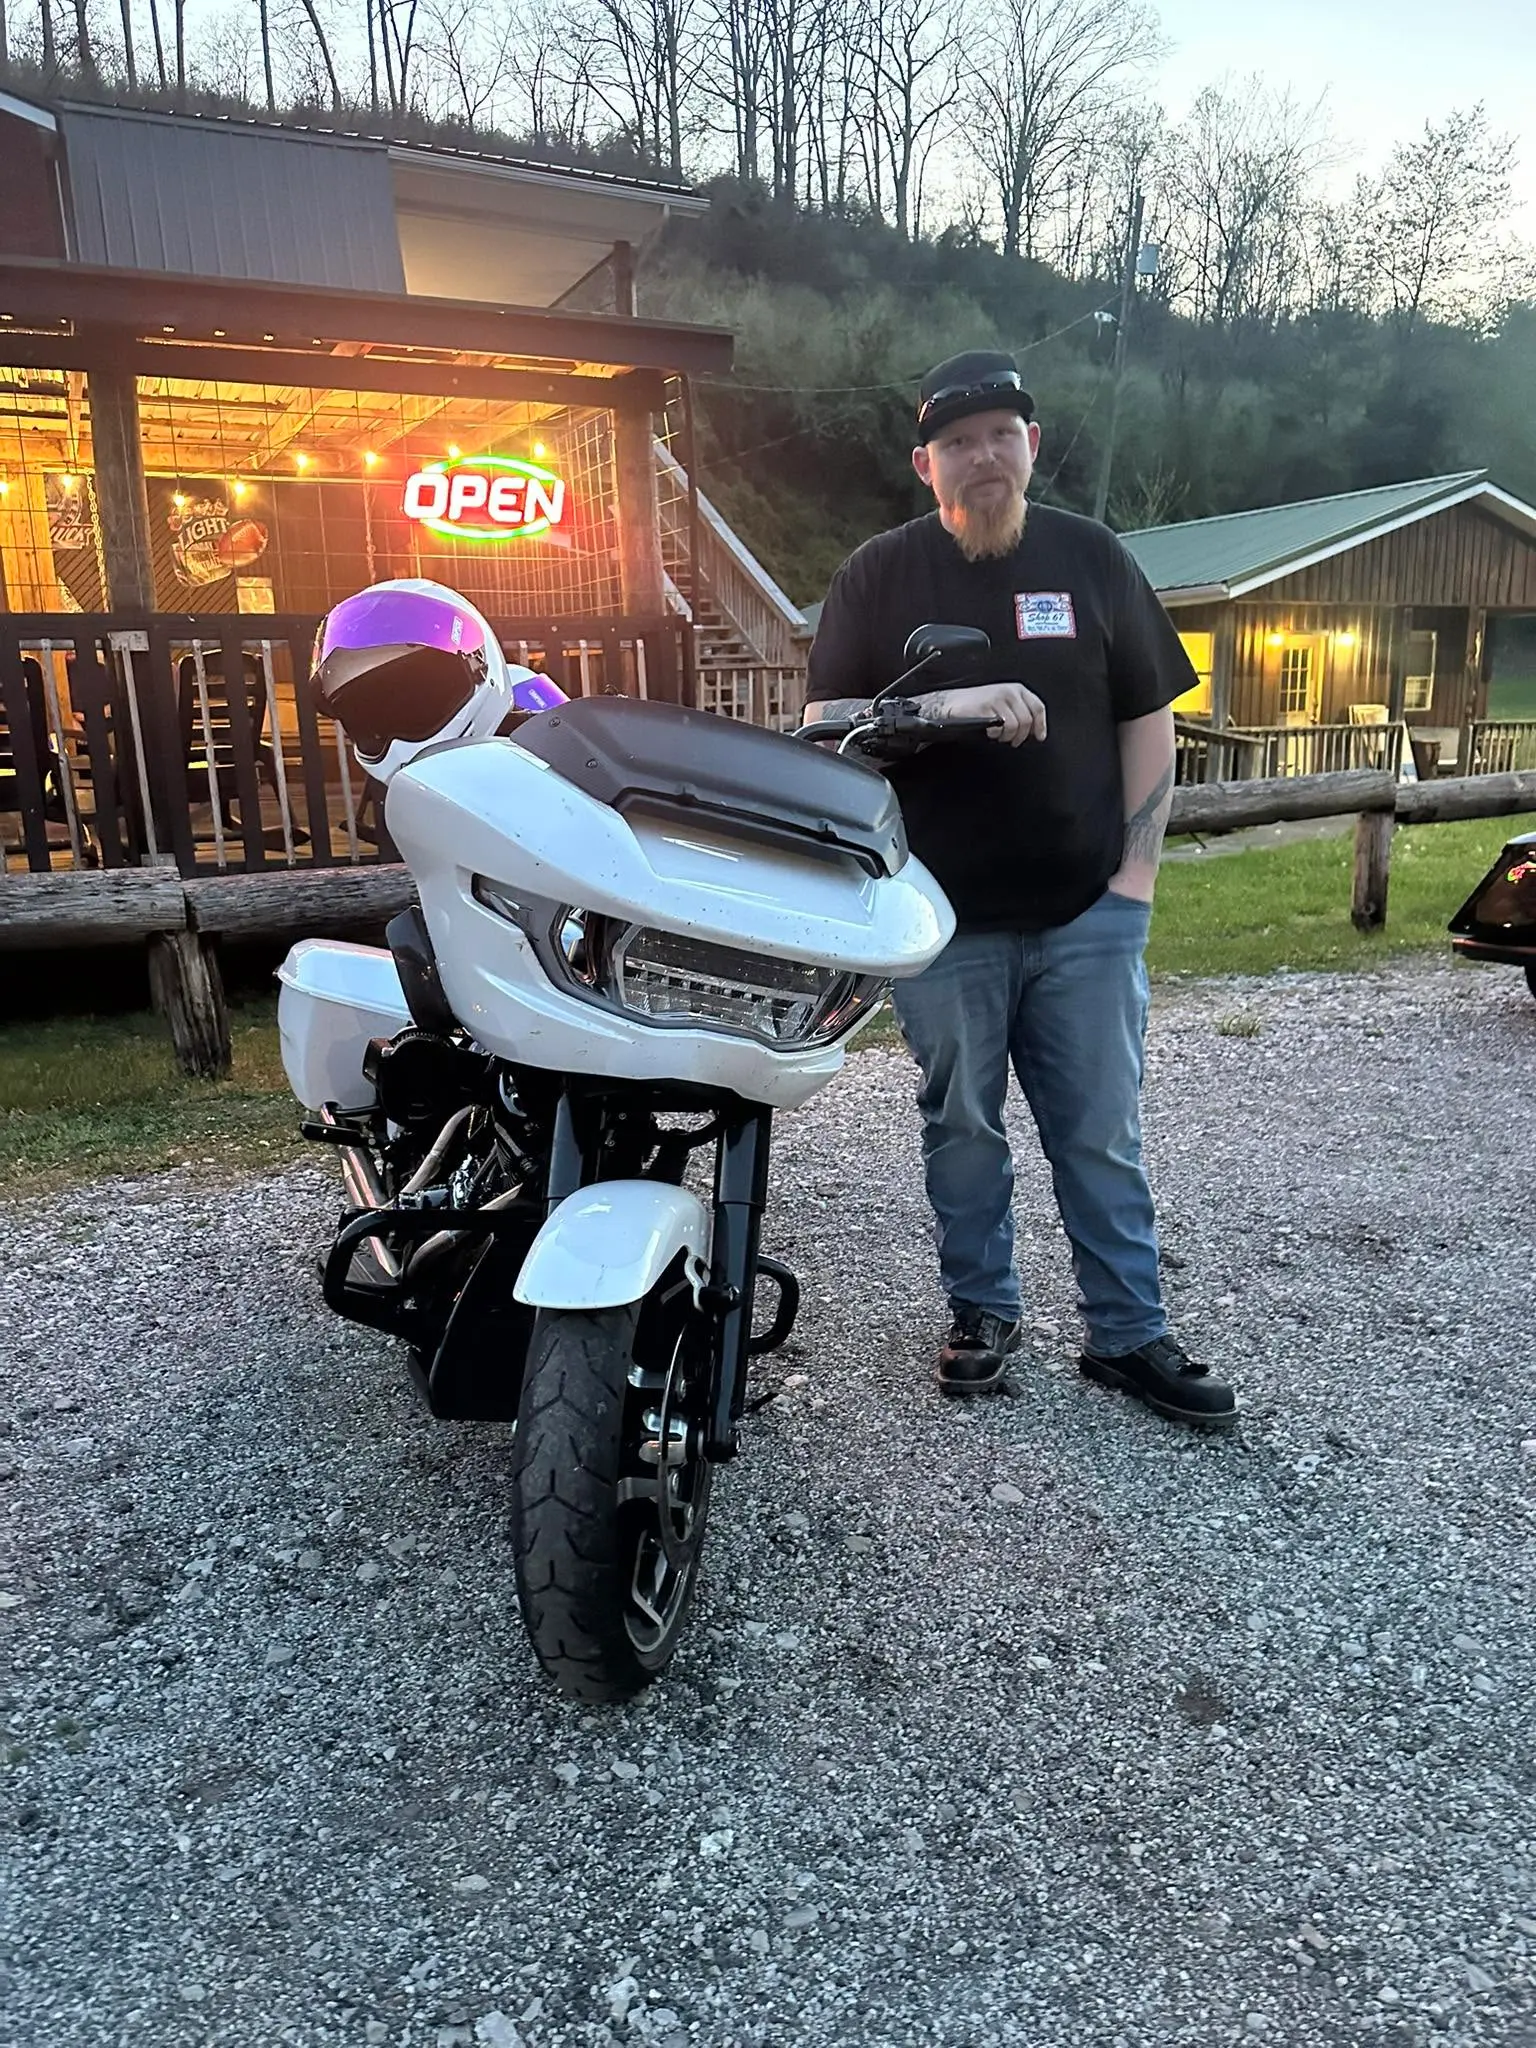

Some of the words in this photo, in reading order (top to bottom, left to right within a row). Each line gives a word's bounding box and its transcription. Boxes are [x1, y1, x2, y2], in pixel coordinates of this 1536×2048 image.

[404, 473, 565, 524] OPEN
[178, 517, 227, 553] LIGHT
[1027, 613, 1050, 624] Shop
